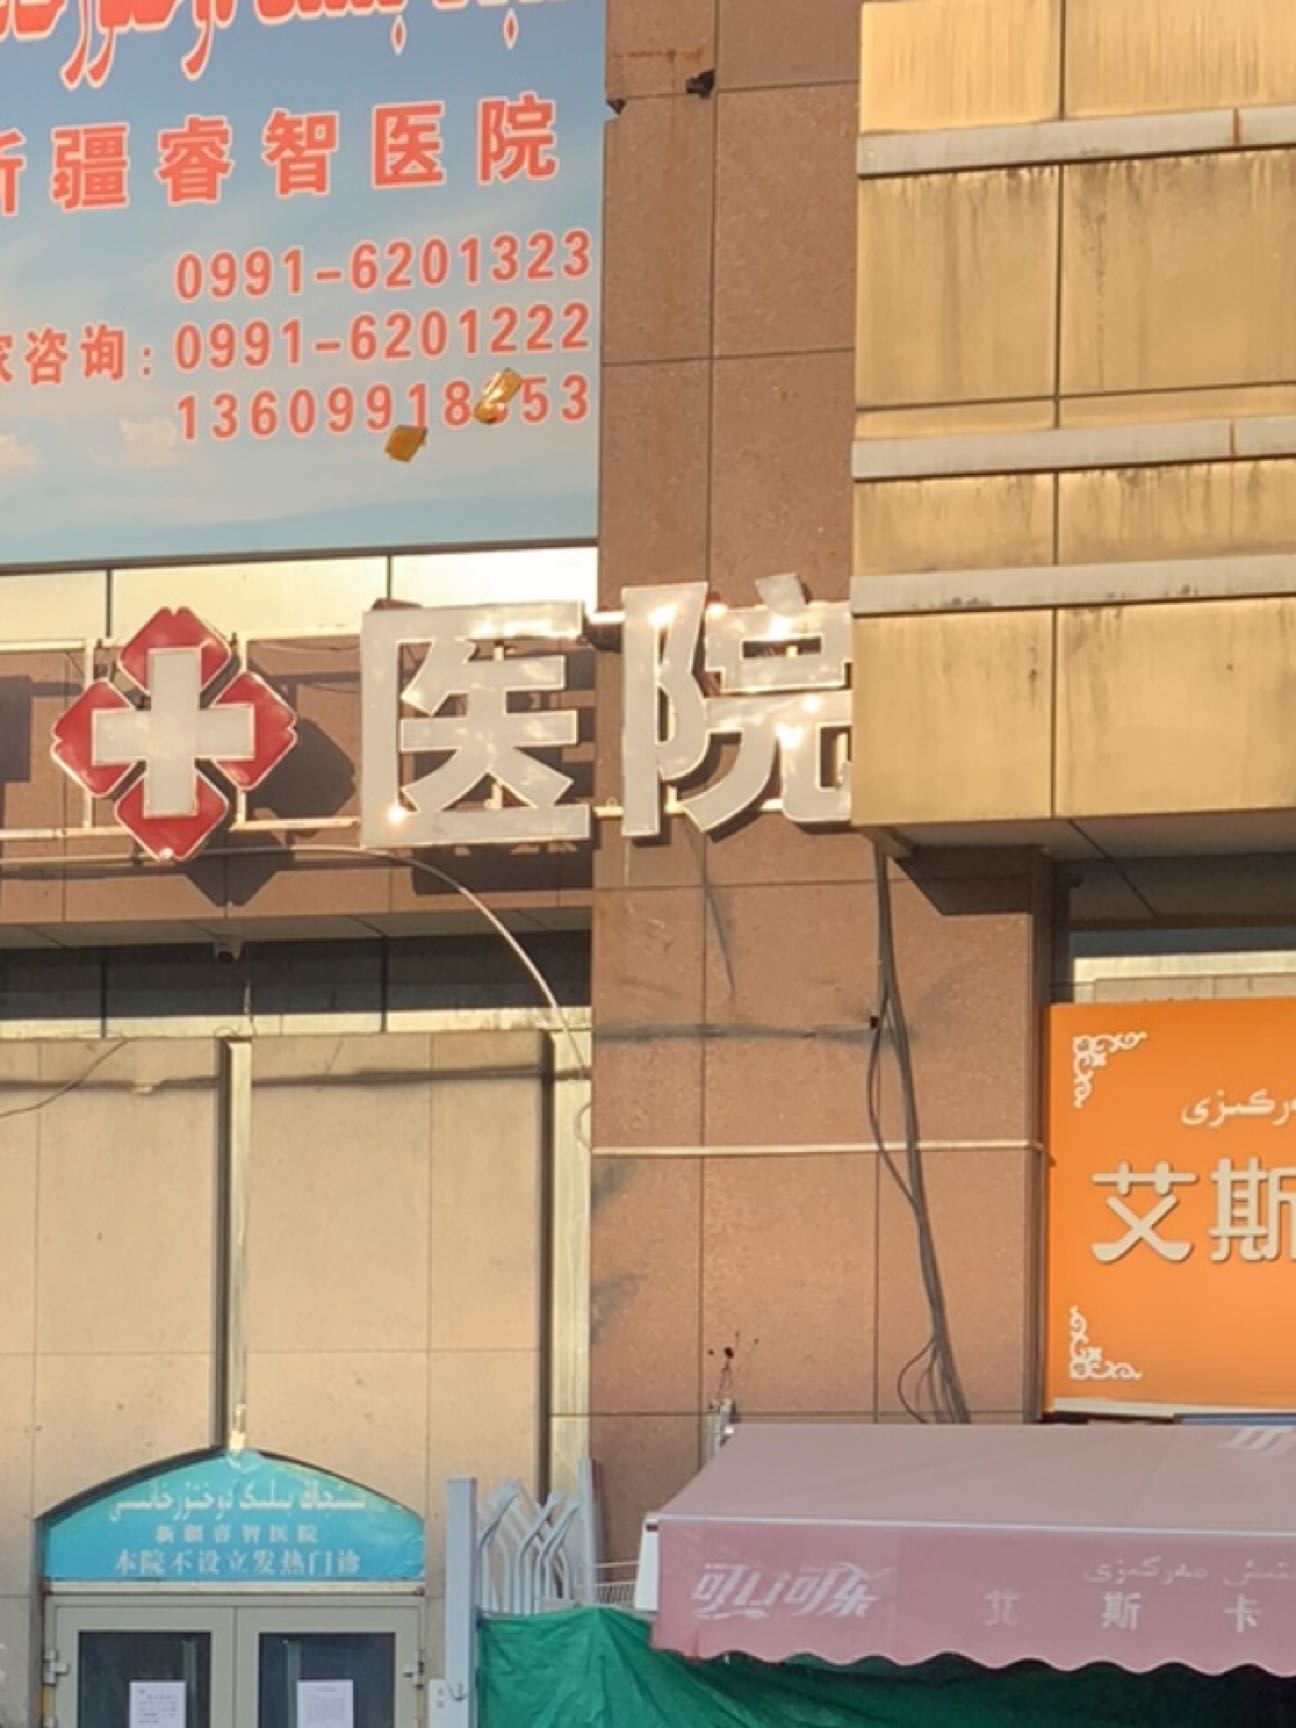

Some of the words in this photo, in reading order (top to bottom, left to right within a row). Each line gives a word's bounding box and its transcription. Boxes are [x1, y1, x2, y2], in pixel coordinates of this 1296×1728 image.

[175, 229, 592, 303] 0991-6201323
[174, 302, 591, 374] 0991-6201222
[177, 373, 589, 442] 1360991853
[359, 573, 852, 850] 医院
[1091, 1156, 1296, 1263] 艾斯
[114, 1549, 362, 1576] 本院不设立发热门诊
[692, 1560, 892, 1620] 可口可乐
